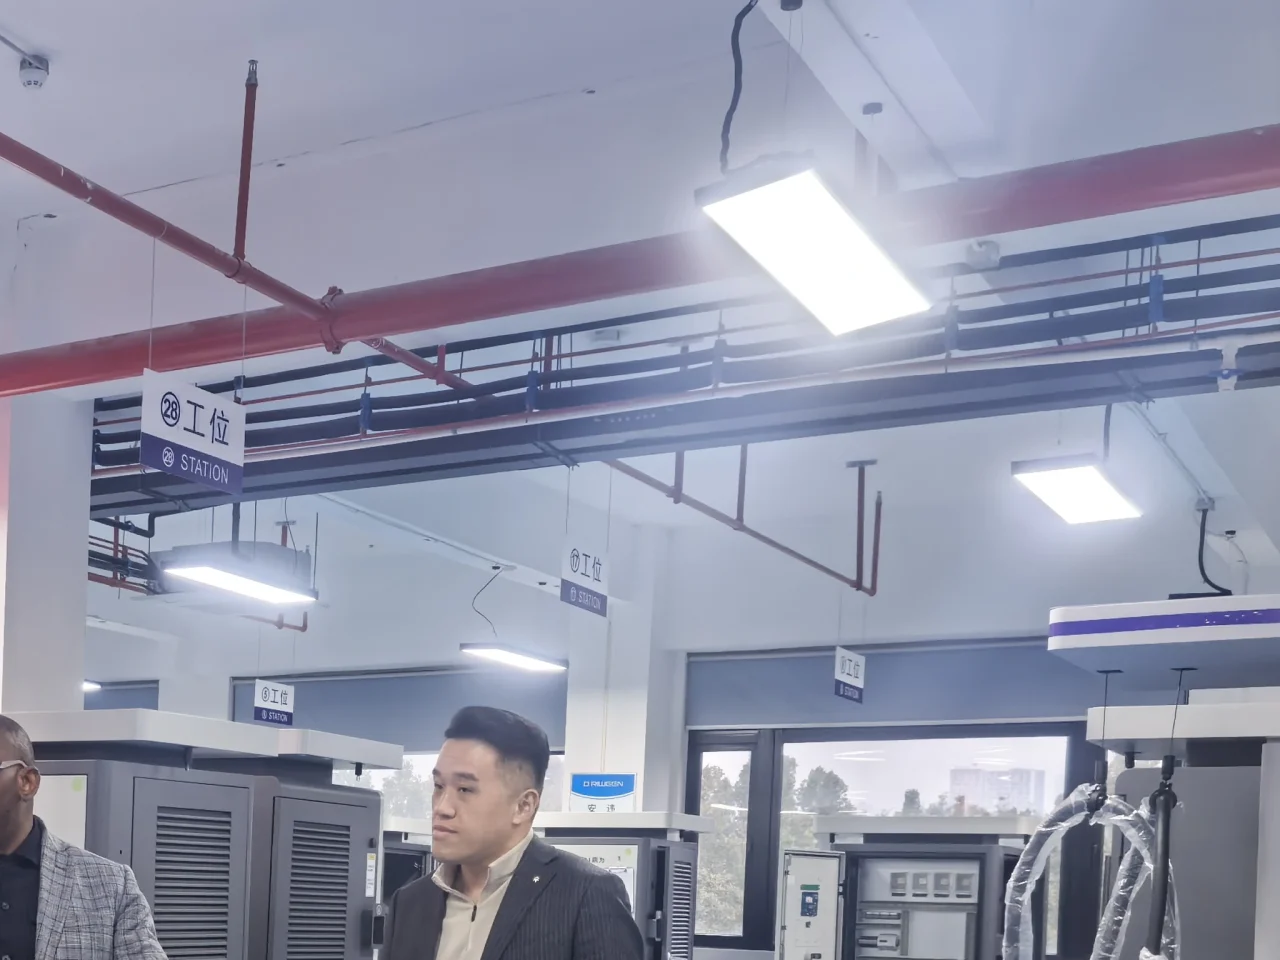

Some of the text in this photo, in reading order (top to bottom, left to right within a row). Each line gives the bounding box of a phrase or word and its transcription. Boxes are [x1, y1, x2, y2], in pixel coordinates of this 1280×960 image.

[180, 453, 229, 484] STATION
[578, 590, 601, 610] STATION
[268, 712, 288, 722] STATION
